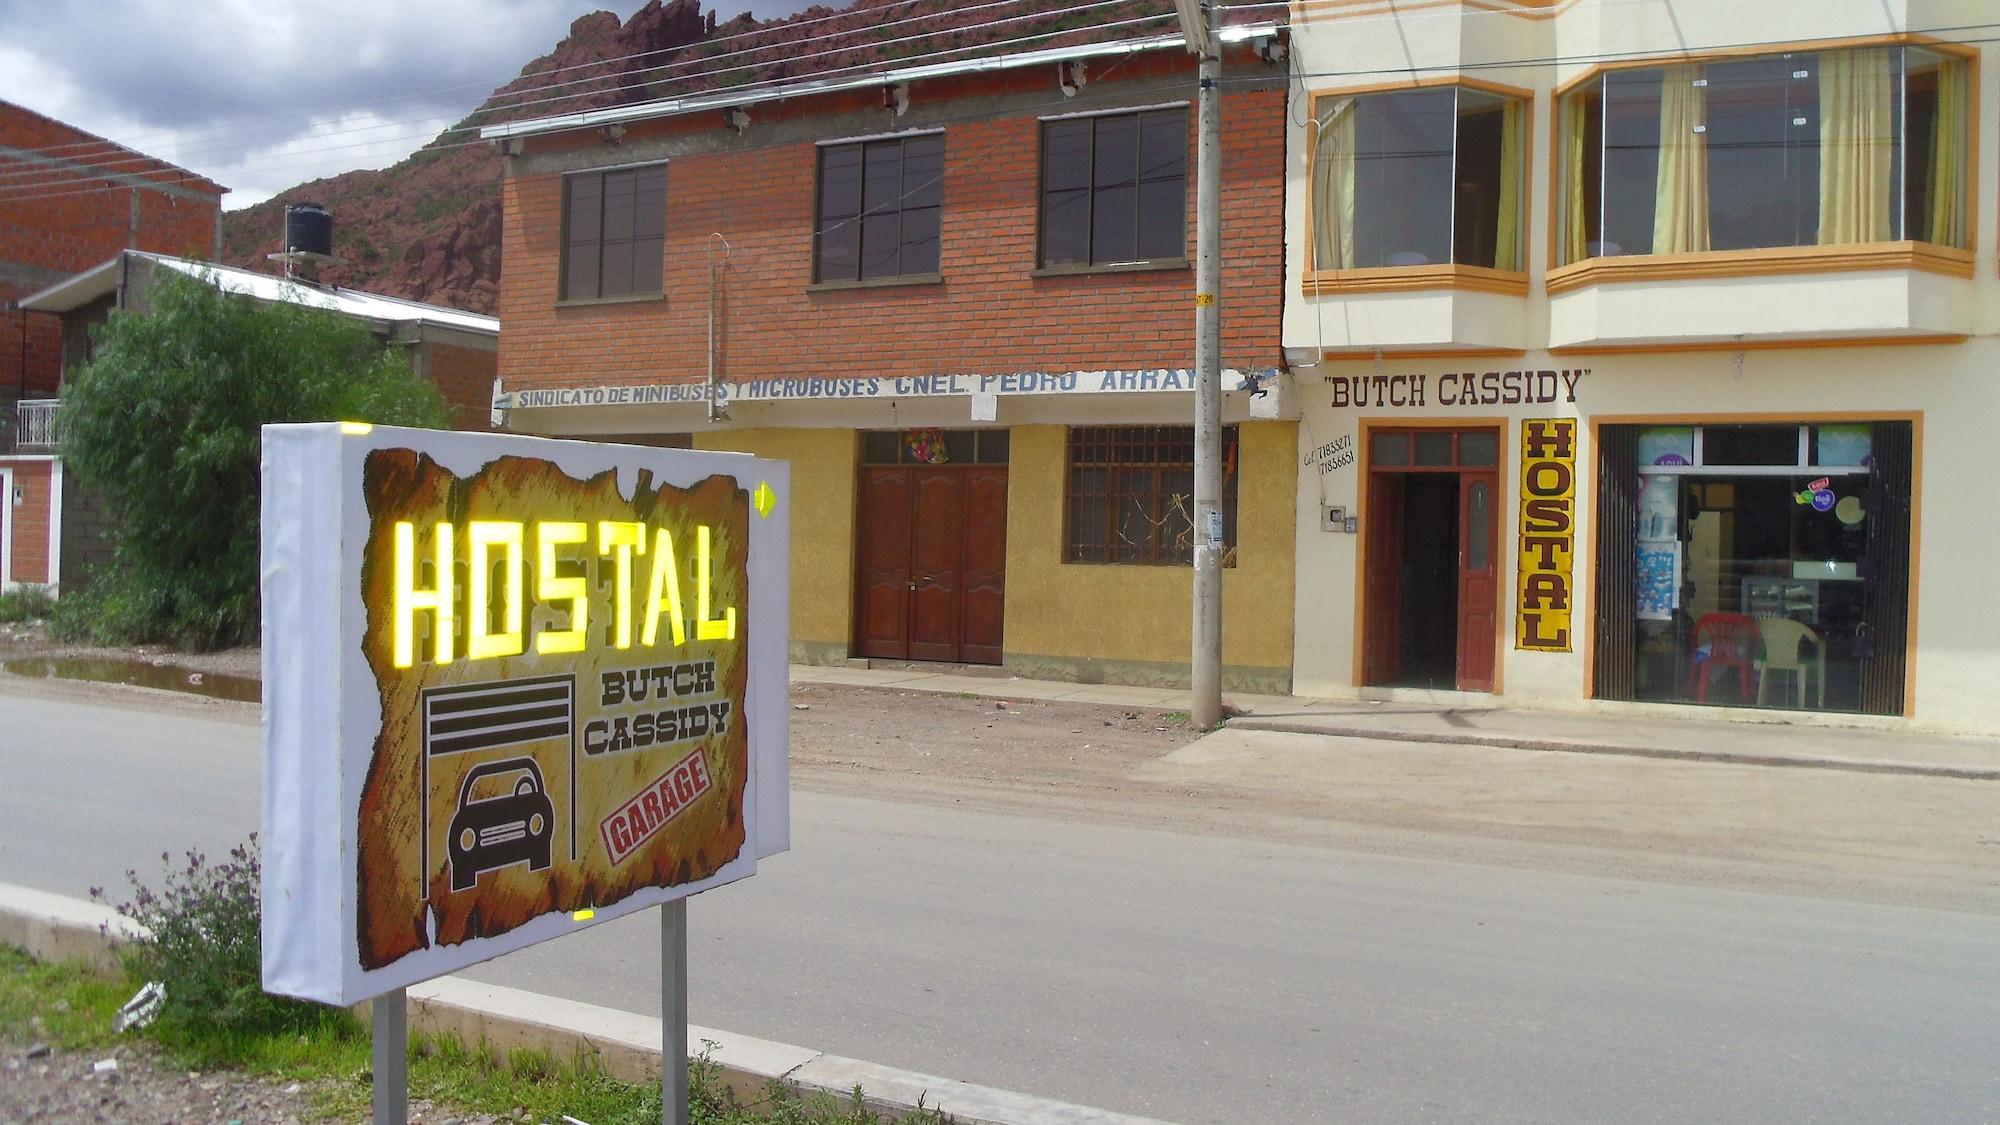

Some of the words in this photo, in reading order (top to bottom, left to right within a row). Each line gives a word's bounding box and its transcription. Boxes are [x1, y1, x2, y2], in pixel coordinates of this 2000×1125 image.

[519, 388, 604, 408] SINDICATO
[608, 387, 630, 403] DE
[633, 383, 728, 403] MINIBUSES
[735, 383, 743, 398] Y
[749, 376, 880, 398] MICROBUSES
[895, 371, 970, 394] CNEL.
[979, 370, 1077, 393] PEDRO
[1324, 374, 1426, 408] "BUTCH
[1438, 369, 1591, 406] CASSIDY"
[1522, 423, 1571, 648] HOSTAL
[394, 520, 736, 669] HOSTAL
[601, 660, 716, 706] BUTCH
[583, 702, 731, 756] CASSIDY
[609, 756, 707, 856] GARAGE
